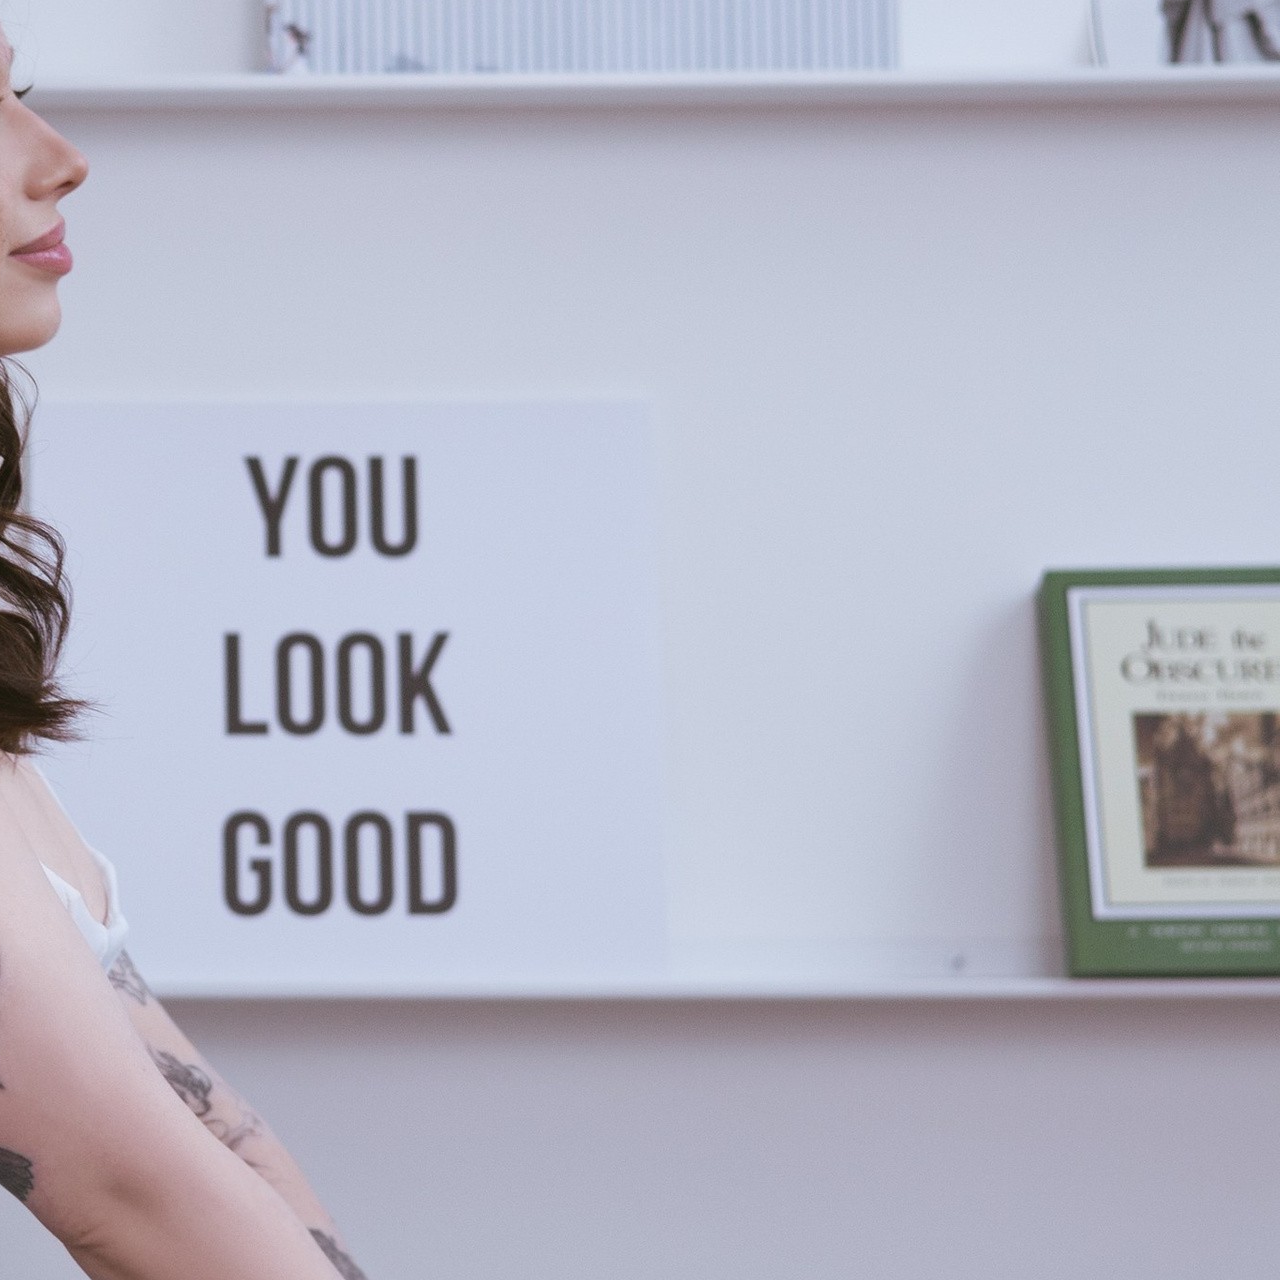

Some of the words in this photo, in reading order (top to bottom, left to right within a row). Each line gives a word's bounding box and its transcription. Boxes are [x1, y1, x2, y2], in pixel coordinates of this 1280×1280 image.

[244, 455, 419, 558] YOU
[223, 632, 453, 735] LOOK
[223, 810, 459, 916] GOOD
